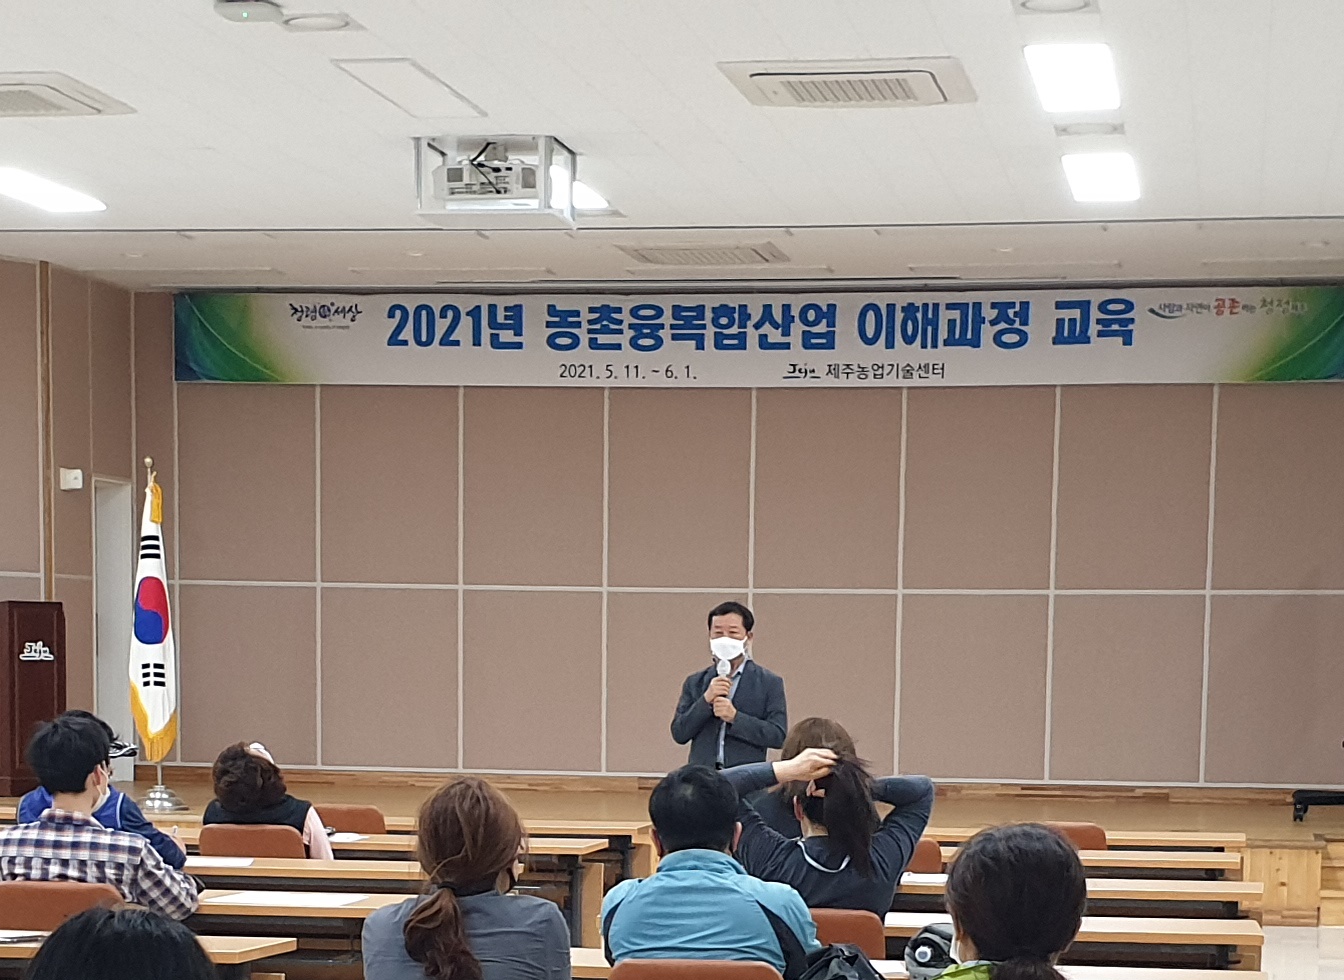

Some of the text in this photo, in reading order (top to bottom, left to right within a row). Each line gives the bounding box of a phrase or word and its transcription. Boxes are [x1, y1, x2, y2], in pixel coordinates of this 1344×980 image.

[386, 298, 1136, 351] 2021년 농촌융복합산업 이해과정 교육
[559, 363, 600, 379] 2021.
[605, 364, 618, 379] 5.
[624, 364, 646, 379] 11.
[825, 362, 945, 379] 제주농업기술센터
